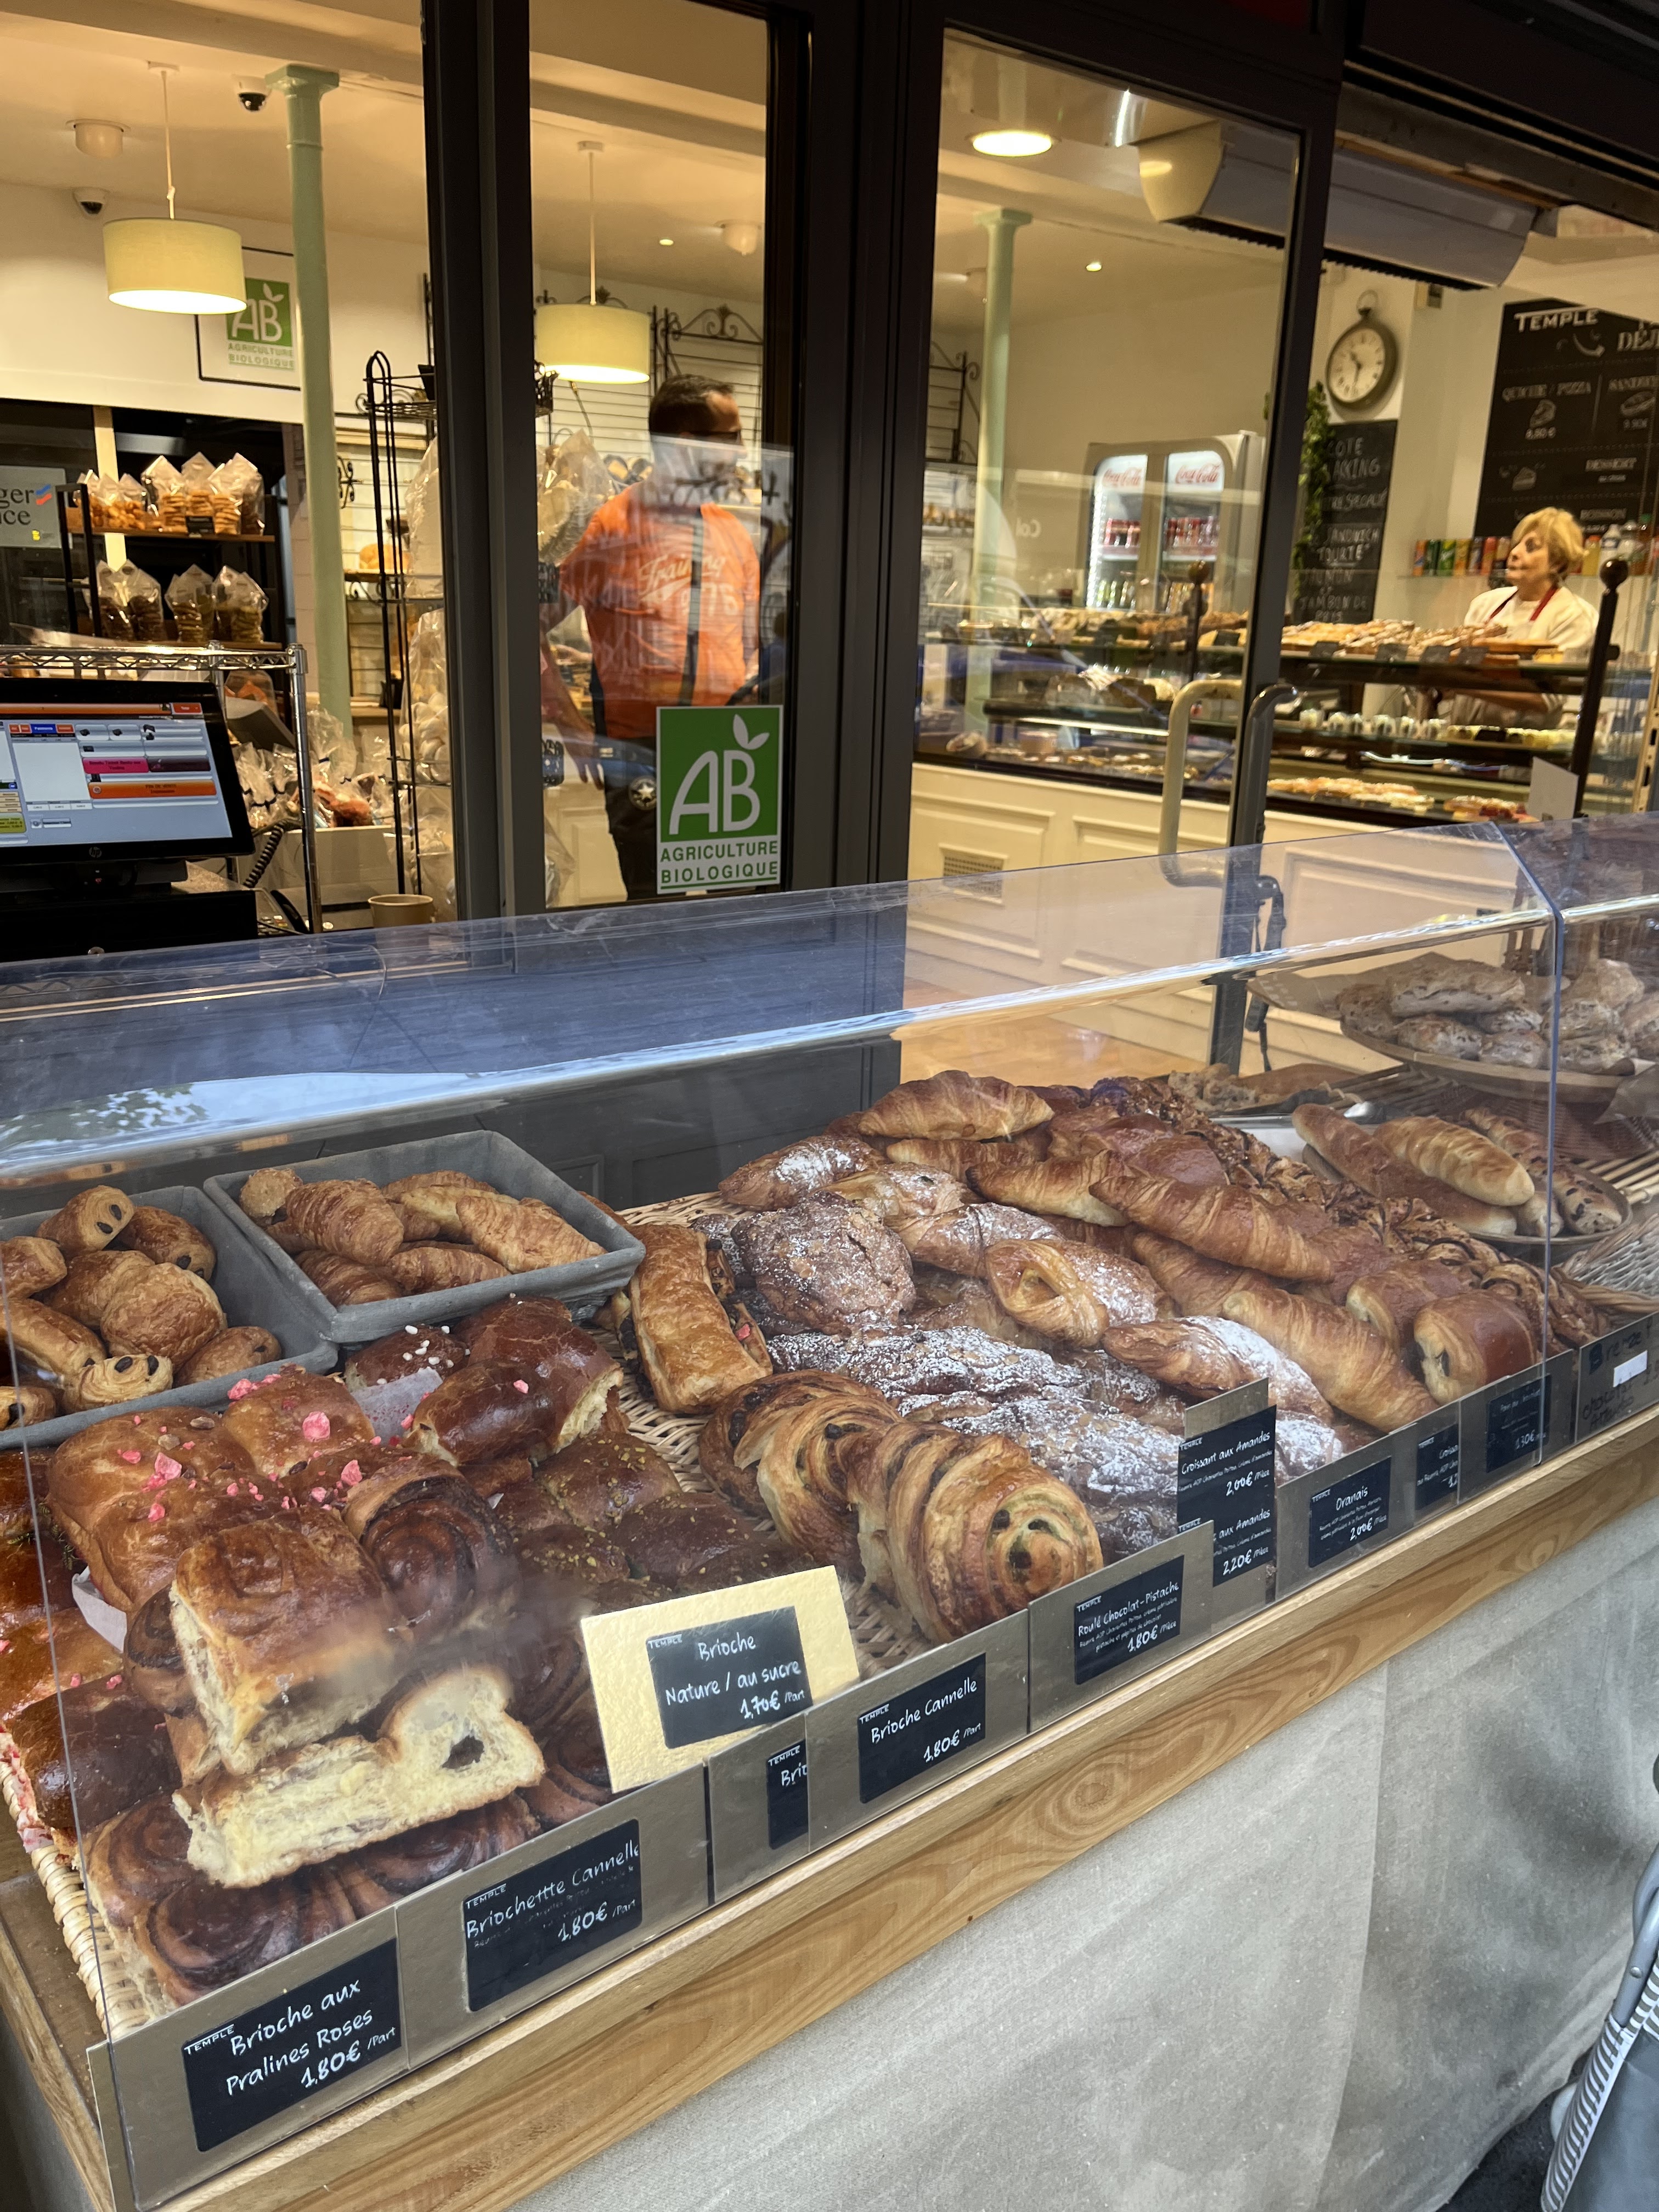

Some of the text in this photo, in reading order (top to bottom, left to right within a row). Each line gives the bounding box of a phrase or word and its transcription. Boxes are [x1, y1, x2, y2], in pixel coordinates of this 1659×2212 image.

[231, 298, 282, 341] AB
[1515, 308, 1599, 332] TEMPLE
[228, 342, 293, 357] AGRICULTURE
[228, 353, 295, 368] BIOLOGIQUE
[0, 509, 31, 525] ce
[669, 750, 760, 835] AB
[661, 840, 778, 862] AGRICULTURE
[661, 861, 778, 883] BIOLOGIQUE
[1182, 1430, 1271, 1475] Croissant aux Amandes
[1226, 1471, 1253, 1497] 2,00€
[1336, 1485, 1368, 1511] Oranais
[1219, 1526, 1234, 1539] aux
[1236, 1508, 1271, 1531] Amandes
[1350, 1517, 1373, 1541] 2,00€
[1223, 1549, 1252, 1576] 2,20€
[1077, 1595, 1102, 1613] TEMPLE
[1078, 1615, 1102, 1637] Roulé
[1127, 1624, 1159, 1653] 1,80€
[647, 1633, 683, 1650] TEMPLE
[698, 1632, 757, 1662] Brioche
[665, 1660, 802, 1706] Nature / au sucre
[741, 1689, 805, 1720] 1,70€ /Part
[859, 1703, 890, 1724] TEMPLE
[871, 1677, 977, 1745] Brioche Cannelle
[768, 1745, 801, 1767] TEMPLE
[923, 1723, 981, 1763] 1,80€ /Part
[466, 1883, 507, 1910] TEMPLE
[466, 1881, 566, 1939] Briochette
[558, 1901, 607, 1943] 1,80€
[612, 1899, 636, 1918] /Part
[230, 1980, 361, 2056] Brioche aux
[184, 2024, 234, 2055] TEMPLE
[226, 2010, 373, 2096] Pralines Roses
[301, 2027, 396, 2089] 1,80€ /Part
